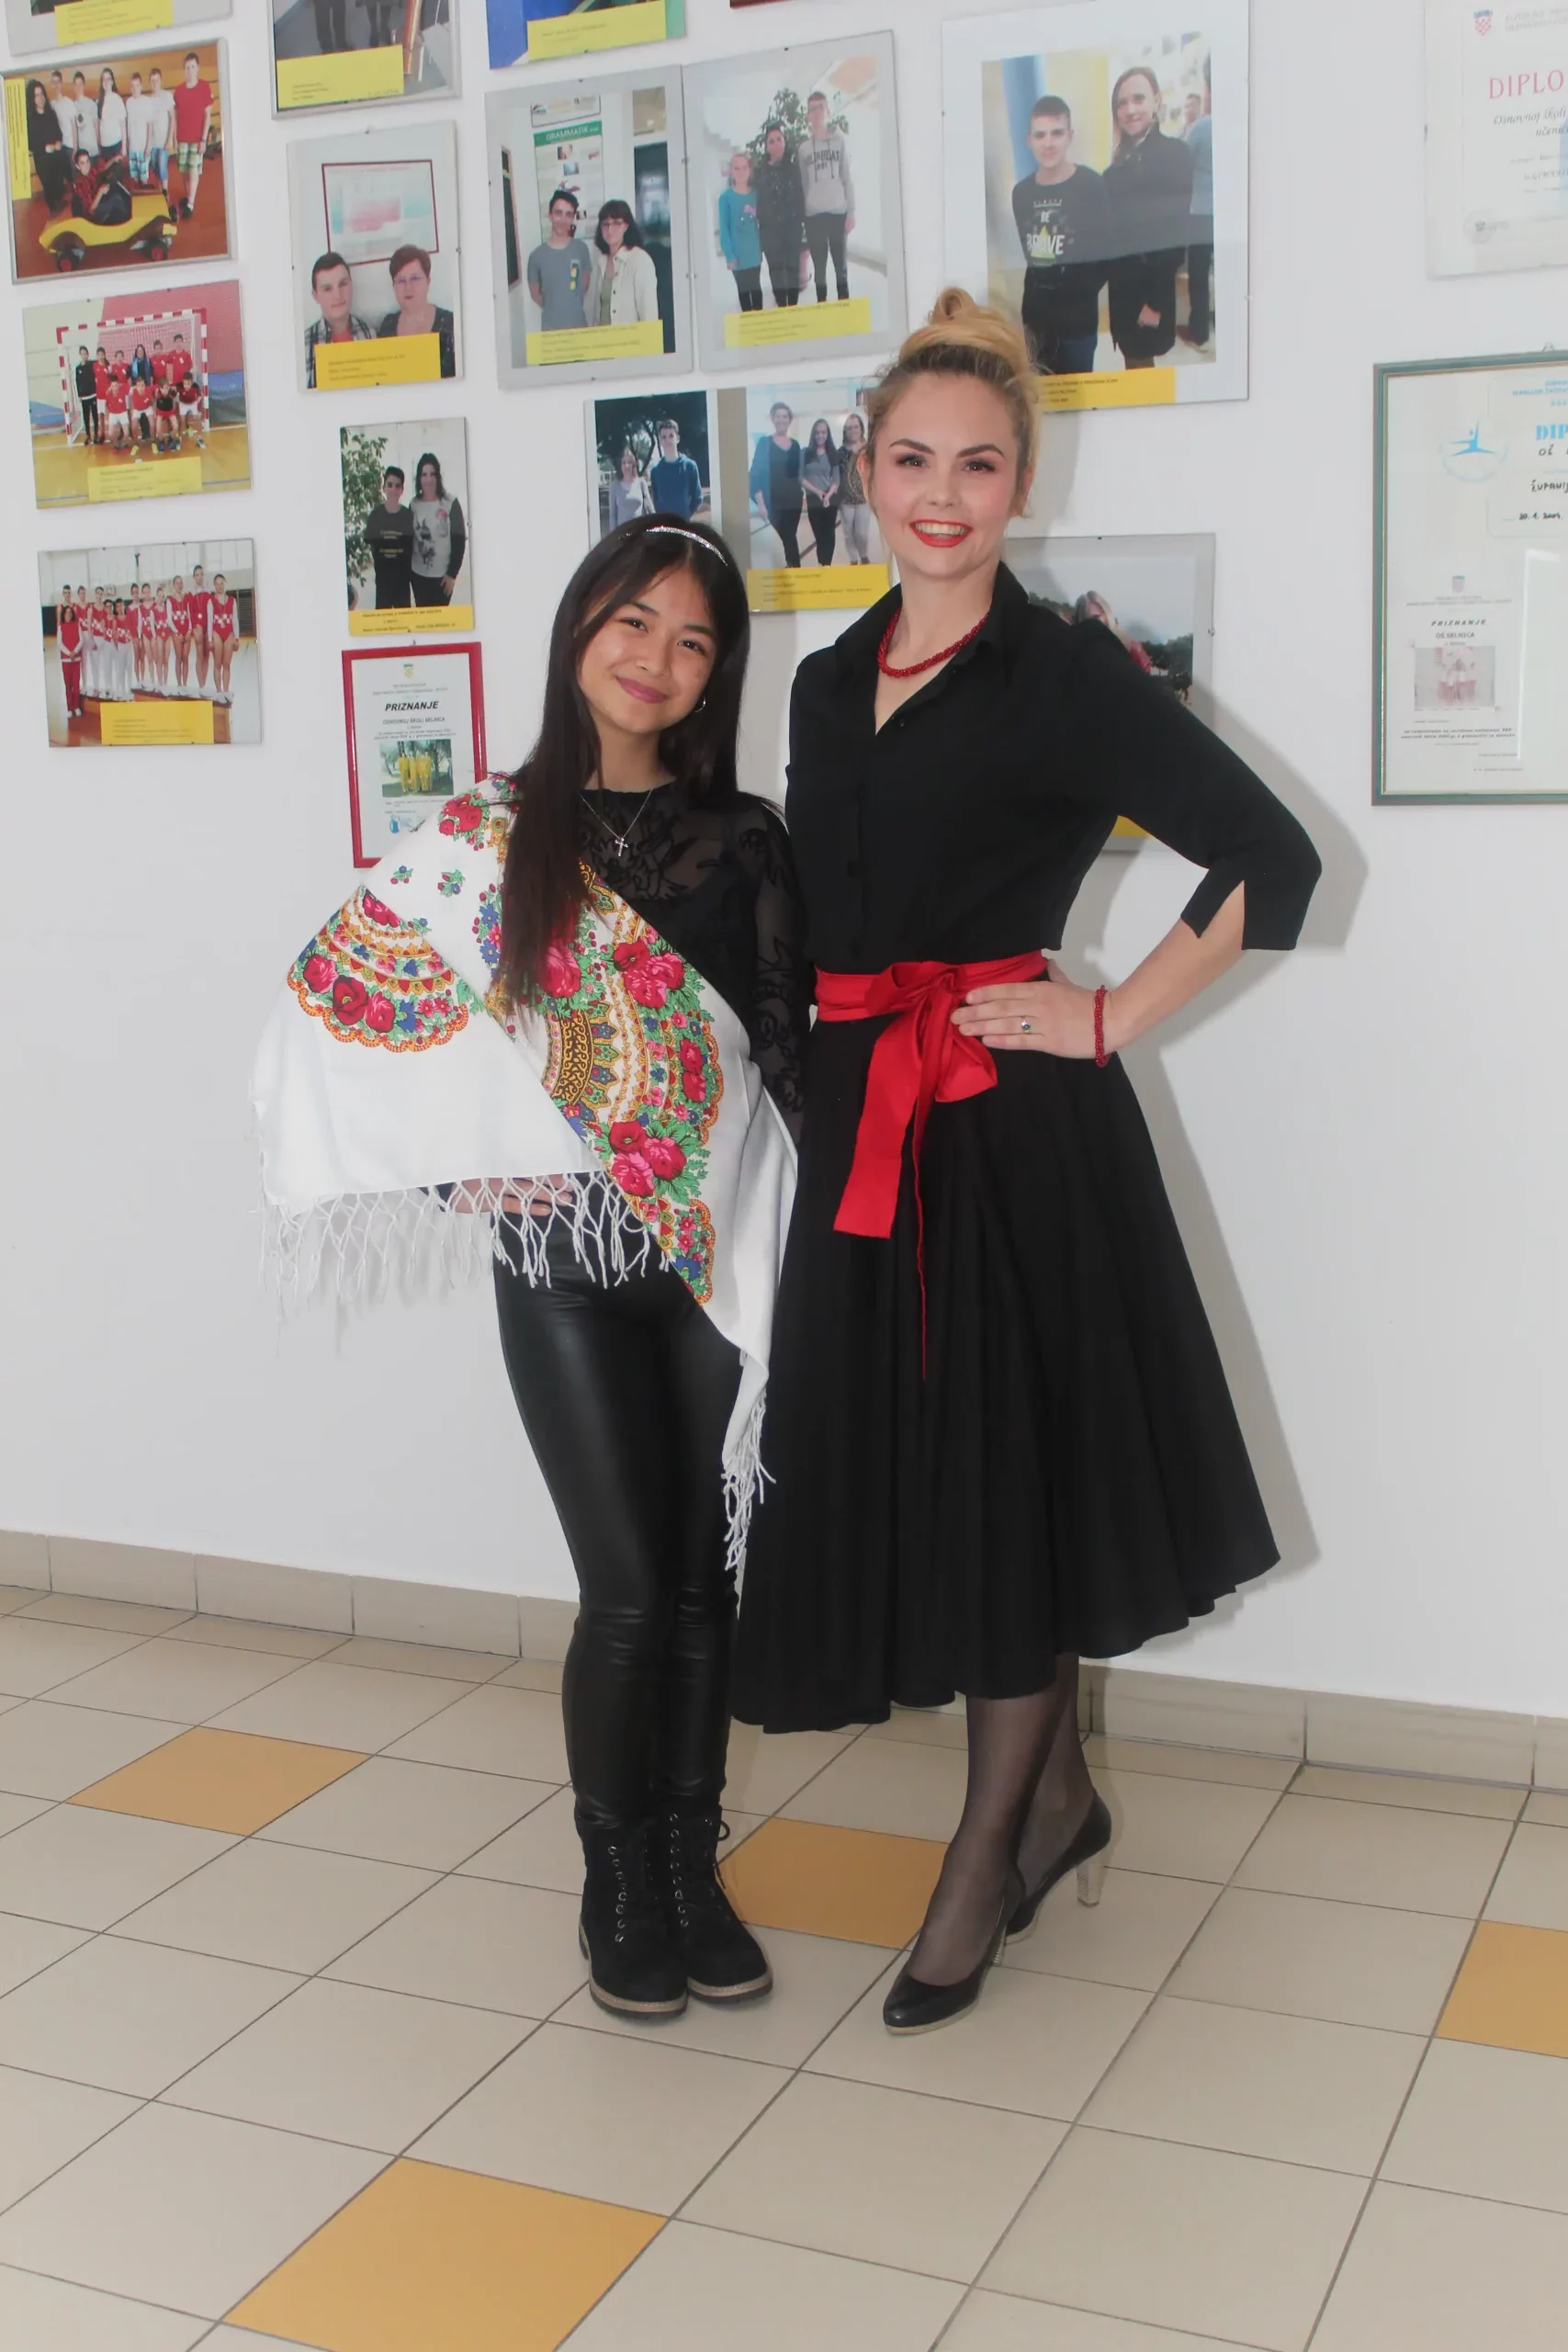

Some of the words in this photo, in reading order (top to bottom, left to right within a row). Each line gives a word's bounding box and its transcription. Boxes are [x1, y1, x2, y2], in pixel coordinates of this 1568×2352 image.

[1489, 69, 1564, 99] DIPLO
[1494, 111, 1540, 125] Osnovnoj
[546, 126, 589, 141] GRAMMATIK
[1026, 232, 1066, 256] BRAVE
[384, 700, 440, 712] PRIZNANJE
